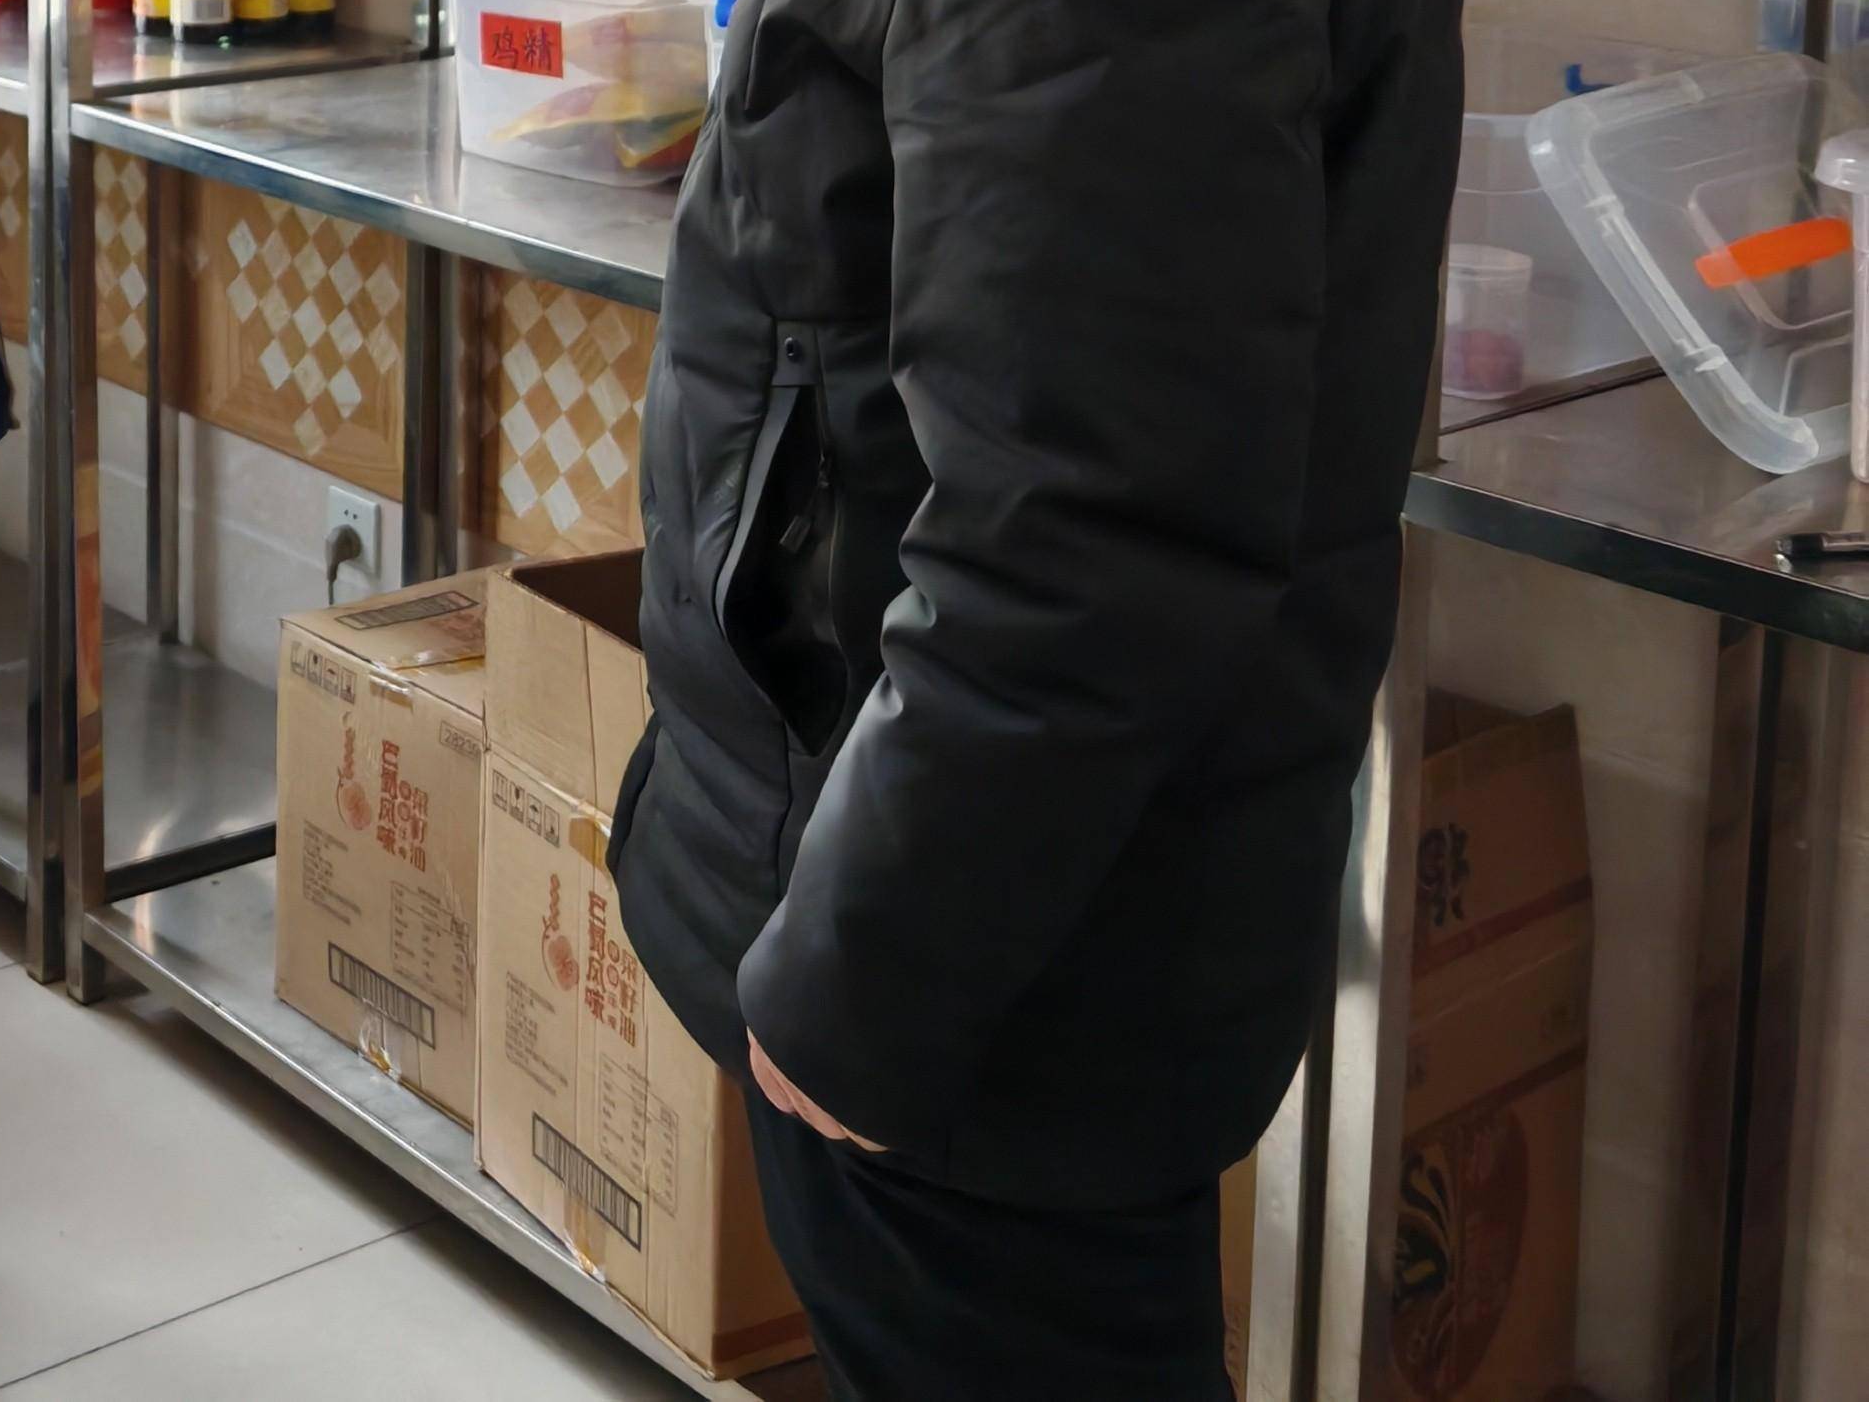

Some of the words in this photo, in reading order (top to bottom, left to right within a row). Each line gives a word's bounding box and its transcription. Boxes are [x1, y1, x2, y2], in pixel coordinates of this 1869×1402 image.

[486, 25, 554, 72] 鸡精
[375, 738, 401, 857] 巴蜀风味
[409, 785, 430, 874] 菜籽油
[583, 889, 608, 1026] 巴蜀风味
[618, 947, 640, 1048] 菜籽油
